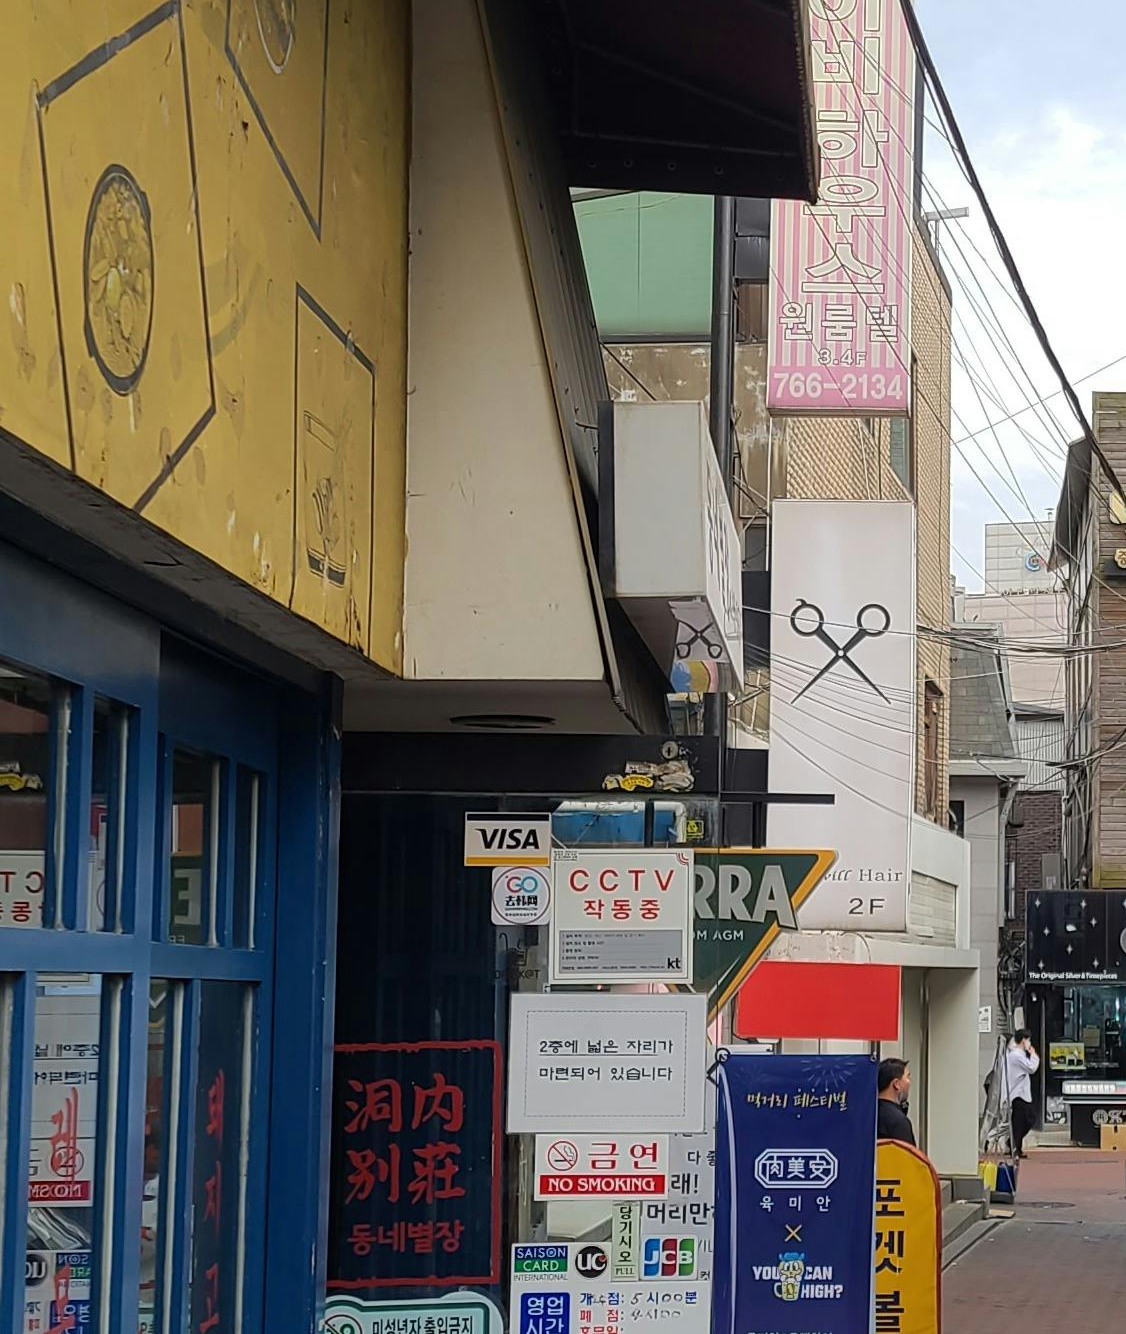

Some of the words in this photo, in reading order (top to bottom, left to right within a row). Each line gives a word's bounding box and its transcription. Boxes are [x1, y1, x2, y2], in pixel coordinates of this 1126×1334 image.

[778, 301, 900, 344] 원룸텔
[773, 370, 904, 401] 766-2134
[474, 827, 541, 851] VISA
[569, 869, 674, 892] CCTV
[859, 868, 903, 882] Hair
[583, 899, 661, 920] 작동중
[848, 897, 887, 915] 2F
[667, 957, 682, 969] kt
[588, 1040, 619, 1054] 넓은
[627, 1040, 674, 1054] 자리가
[539, 1067, 601, 1081] 마련되어
[611, 1067, 673, 1081] 있습니다
[747, 1091, 788, 1108] 먹거리
[793, 1090, 848, 1112] 페스티벌
[588, 1141, 659, 1171] 금연
[548, 1177, 574, 1192] NO
[577, 1177, 656, 1193] SMOKING
[647, 1202, 715, 1225] 머리만
[347, 1219, 465, 1256] 동네별장
[618, 1205, 635, 1263] 당기시오
[516, 1247, 566, 1259] SAISON
[643, 1250, 693, 1265] JCB
[522, 1260, 560, 1271] CARD
[615, 1267, 635, 1275] PULL
[803, 1266, 833, 1281] CAN
[513, 1273, 568, 1281] INTERNATIONAL
[800, 1284, 844, 1299] HIGH?
[527, 1296, 564, 1316] 영업
